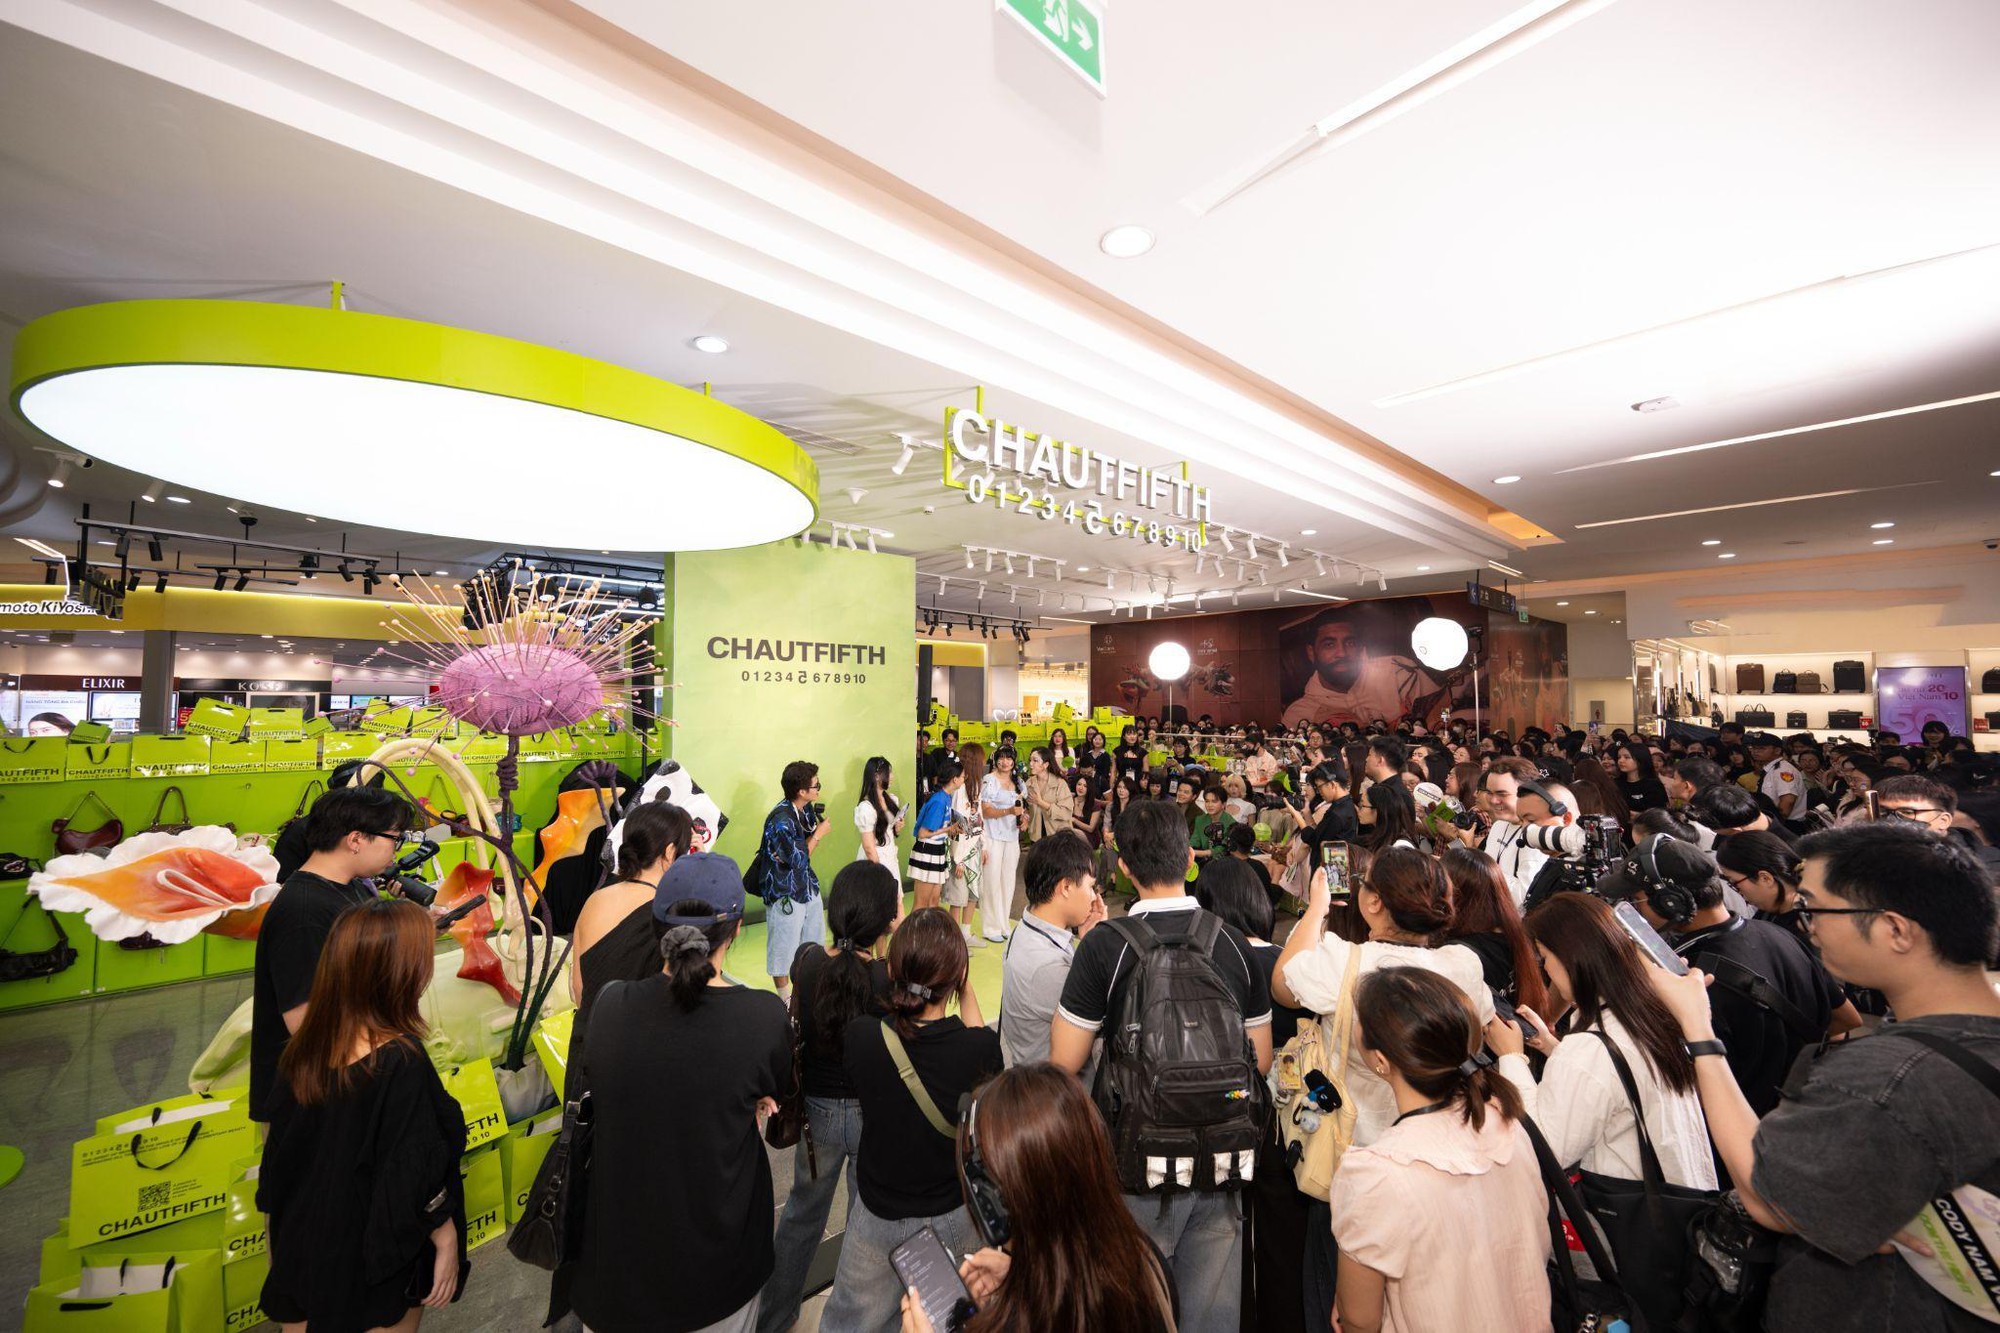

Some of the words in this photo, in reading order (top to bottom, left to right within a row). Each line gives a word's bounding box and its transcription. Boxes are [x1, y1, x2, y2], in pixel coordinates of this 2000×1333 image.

[948, 409, 1212, 522] CHAUTFIFTH
[707, 636, 886, 665] CHAUTFIFTH
[82, 678, 125, 688] ELIXIR
[1928, 684, 1946, 692] 20
[1944, 692, 1959, 700] 10
[68, 768, 129, 776] CHAUTFIFTH
[98, 1192, 227, 1237] CHAUTFIFTH
[1935, 1198, 1974, 1243] CODY
[1964, 1244, 1998, 1283] NAM
